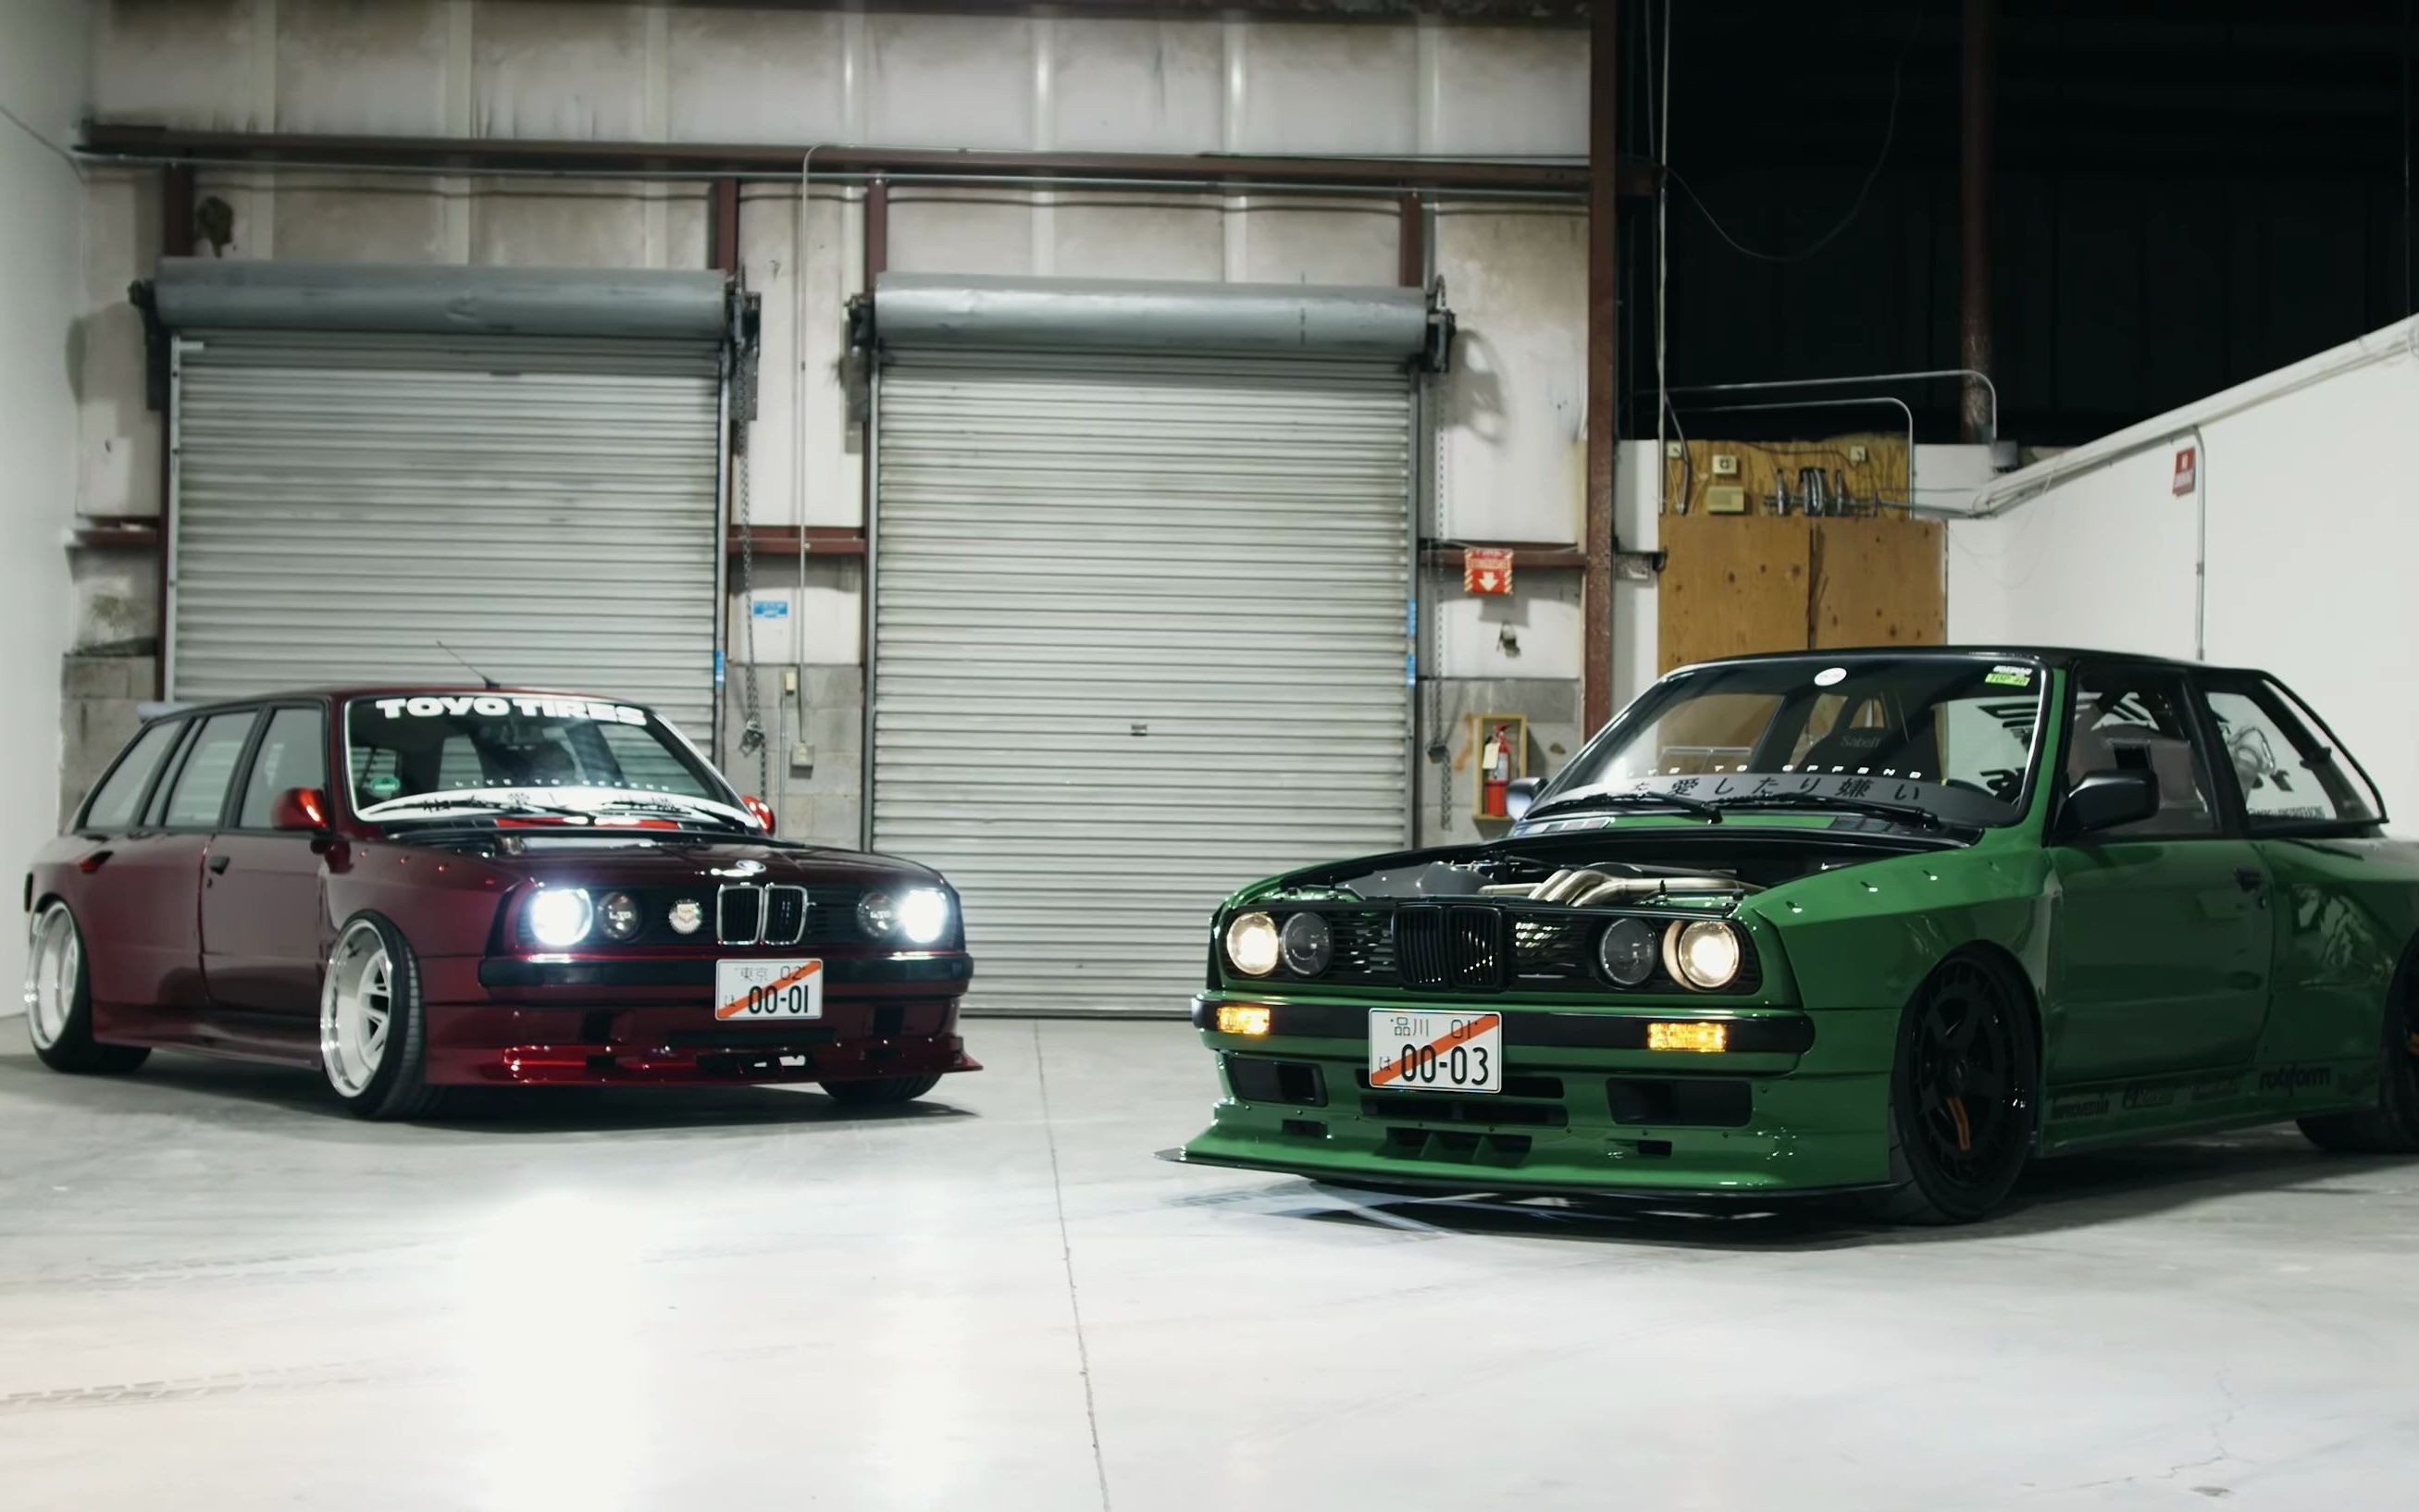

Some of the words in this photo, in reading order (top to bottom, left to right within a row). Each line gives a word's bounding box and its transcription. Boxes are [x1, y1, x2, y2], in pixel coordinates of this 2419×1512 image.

[376, 697, 509, 718] TOYO
[513, 698, 647, 726] TIRES
[1715, 764, 1748, 773] TO
[1781, 764, 1922, 779] OFFEND
[748, 985, 809, 1014] 00-01
[1394, 1017, 1430, 1037] 品川
[1379, 1056, 1392, 1072] は
[1401, 1043, 1489, 1085] 00-03
